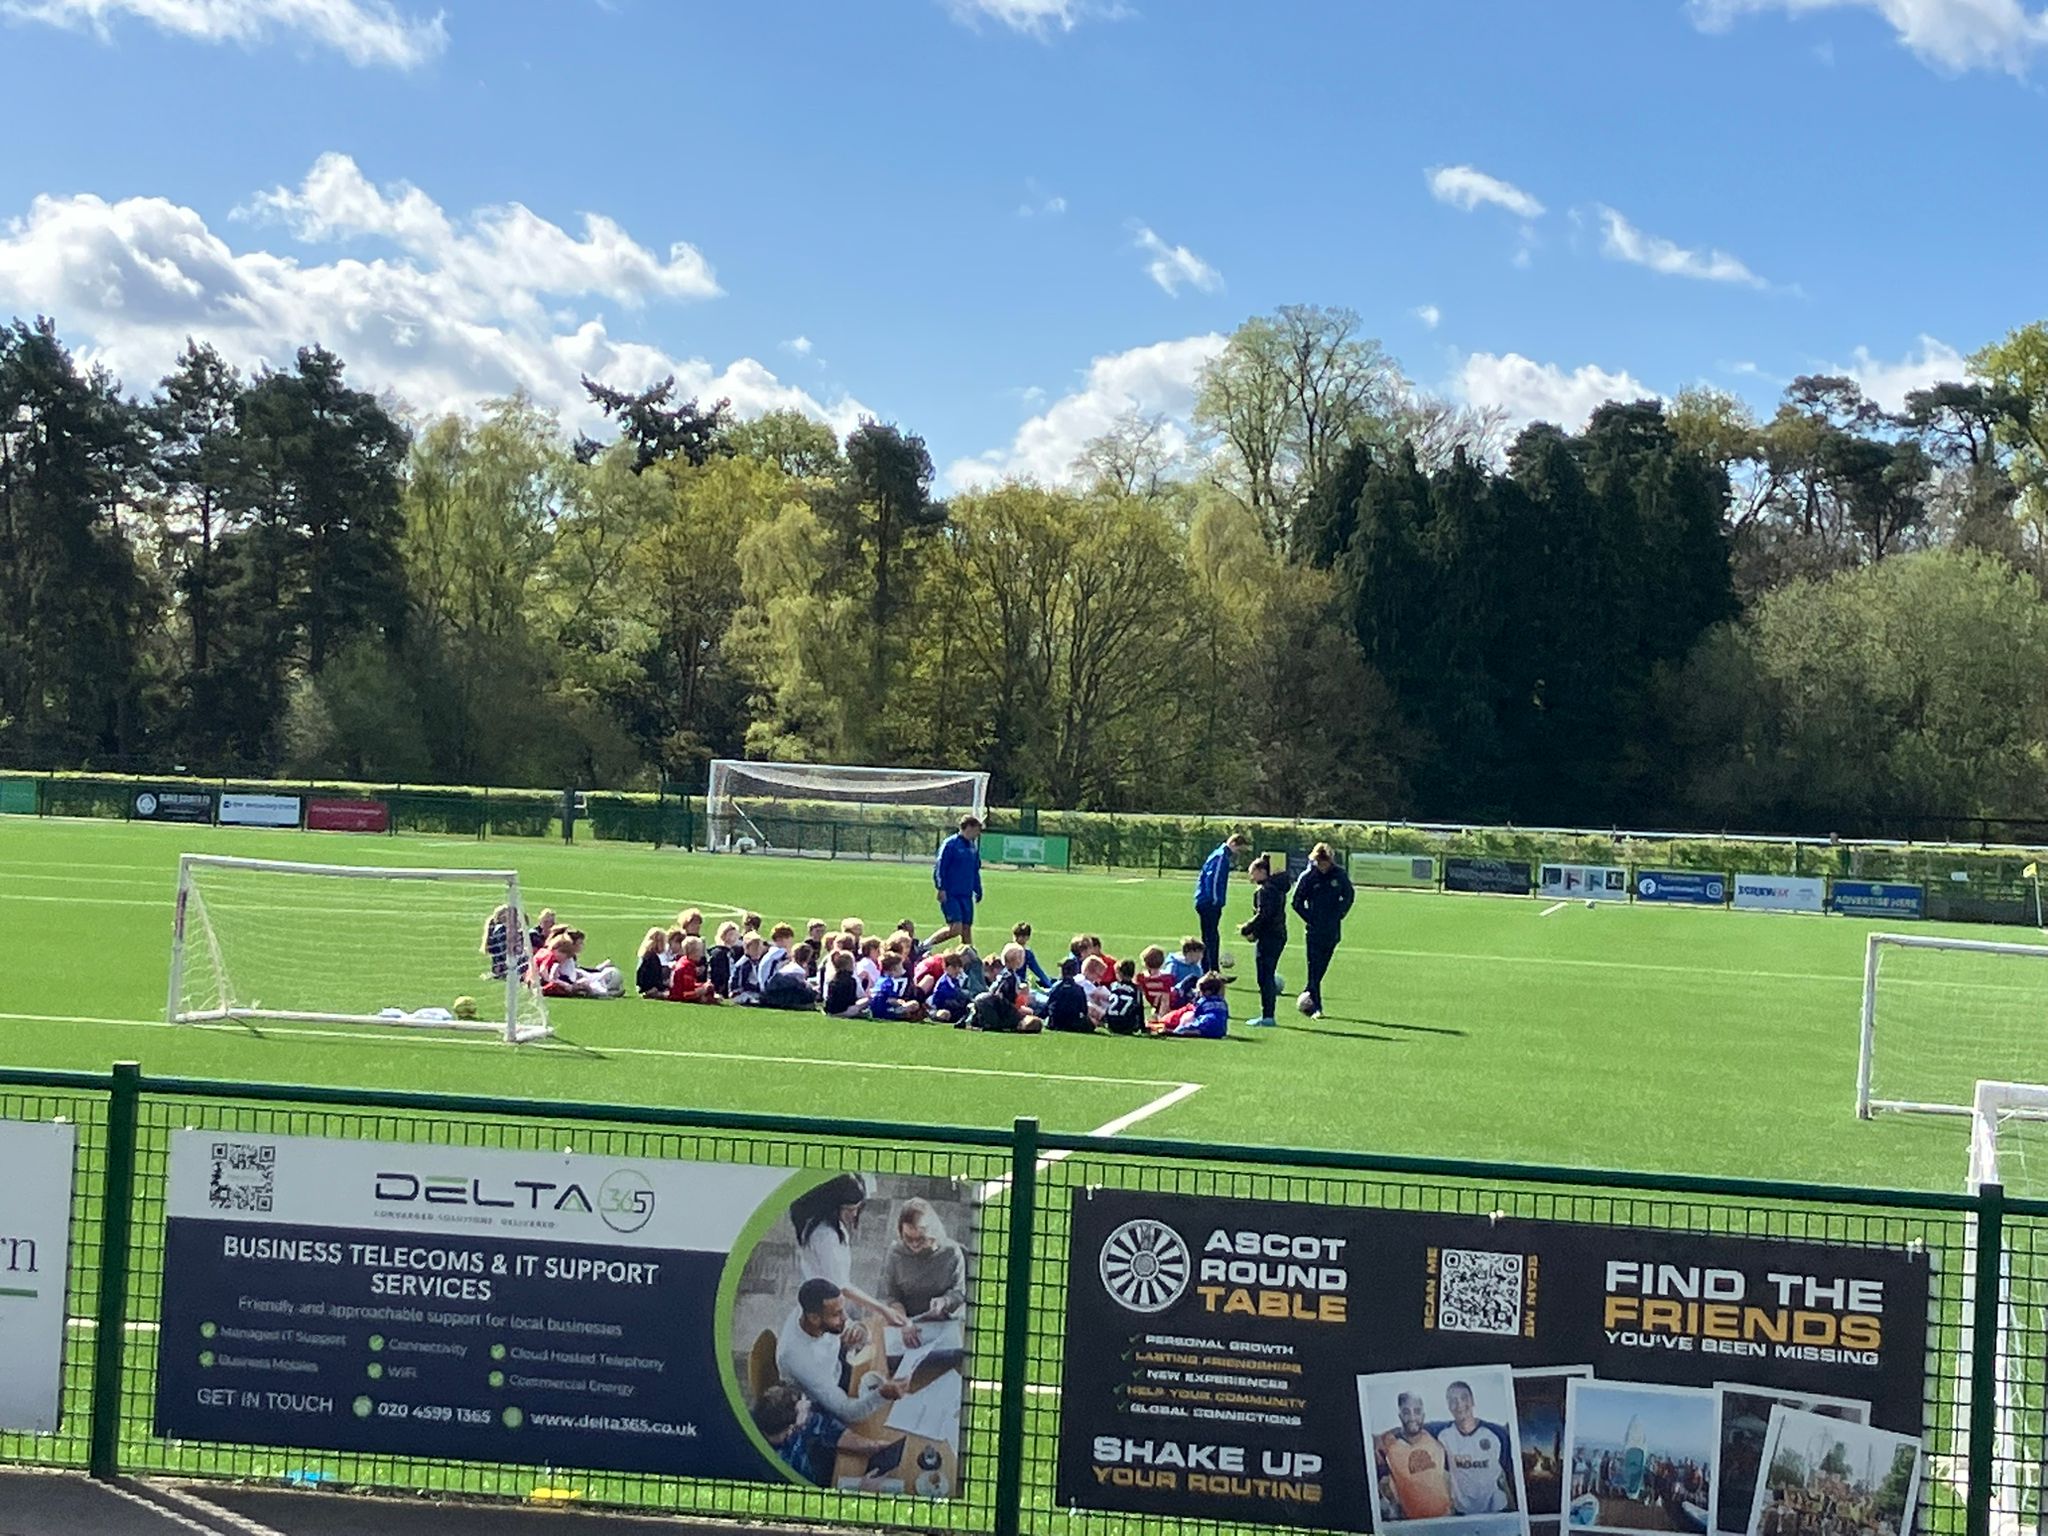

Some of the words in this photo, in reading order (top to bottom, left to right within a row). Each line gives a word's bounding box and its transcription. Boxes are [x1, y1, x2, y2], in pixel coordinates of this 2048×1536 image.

[1108, 993, 1134, 1016] 27
[375, 1172, 593, 1213] DELTA
[607, 1187, 655, 1213] 365
[1203, 1229, 1347, 1261] ASCOT
[223, 1235, 342, 1265] BUSINESS
[349, 1244, 484, 1273] TELECOMS
[491, 1253, 508, 1275] &
[515, 1255, 539, 1277] IT
[544, 1257, 660, 1285] SUPPORT
[1200, 1257, 1347, 1291] ROUND
[1426, 1247, 1438, 1274] ME
[371, 1272, 492, 1301] SERVICES
[1526, 1254, 1539, 1306] SCAN
[1605, 1260, 1746, 1301] FIND
[1767, 1272, 1884, 1313] THE
[238, 1295, 294, 1315] Friendly
[299, 1301, 325, 1314] and
[328, 1303, 424, 1321] approachable
[427, 1310, 481, 1327] support
[486, 1312, 507, 1327] for
[510, 1315, 544, 1330] local
[547, 1316, 623, 1336] businesses
[1197, 1285, 1347, 1322] TABLE
[1424, 1278, 1436, 1329] SCAN
[1524, 1310, 1536, 1338] ME
[1604, 1296, 1882, 1349] FRIENDS
[388, 1337, 468, 1357] Connectivity
[1144, 1334, 1226, 1350] PERSONAL
[1229, 1340, 1295, 1355] GROWTH
[1604, 1329, 1694, 1351] YOU'VE
[1701, 1337, 1767, 1357] BEEN
[1774, 1343, 1880, 1366] MISSING
[510, 1346, 548, 1361] Cloud
[550, 1349, 596, 1365] Hosted
[599, 1353, 665, 1373] Telephony
[1135, 1351, 1199, 1366] LASTING
[1202, 1357, 1303, 1374] FRIENDSHIPS
[509, 1374, 586, 1391] Commercial
[589, 1379, 635, 1397] Energy
[1146, 1369, 1181, 1382] NEW
[1185, 1373, 1289, 1390] EXPERIENCES
[197, 1387, 237, 1406] GET
[241, 1391, 260, 1408] IN
[266, 1392, 334, 1413] TOUCH
[1126, 1385, 1164, 1397] HELP
[1171, 1388, 1211, 1401] YOUR
[1215, 1392, 1307, 1409] COMMUNITY
[377, 1402, 409, 1418] 020
[412, 1405, 453, 1421] 4599
[530, 1411, 697, 1437] www.delta365.co.uk
[1130, 1402, 1189, 1417] GLOBAL
[1192, 1407, 1302, 1426] CONNECTIONS
[1092, 1435, 1245, 1473] SHAKE
[1261, 1449, 1323, 1478] UP
[1091, 1464, 1177, 1490] YOUR
[1187, 1473, 1323, 1503] ROUTINE
